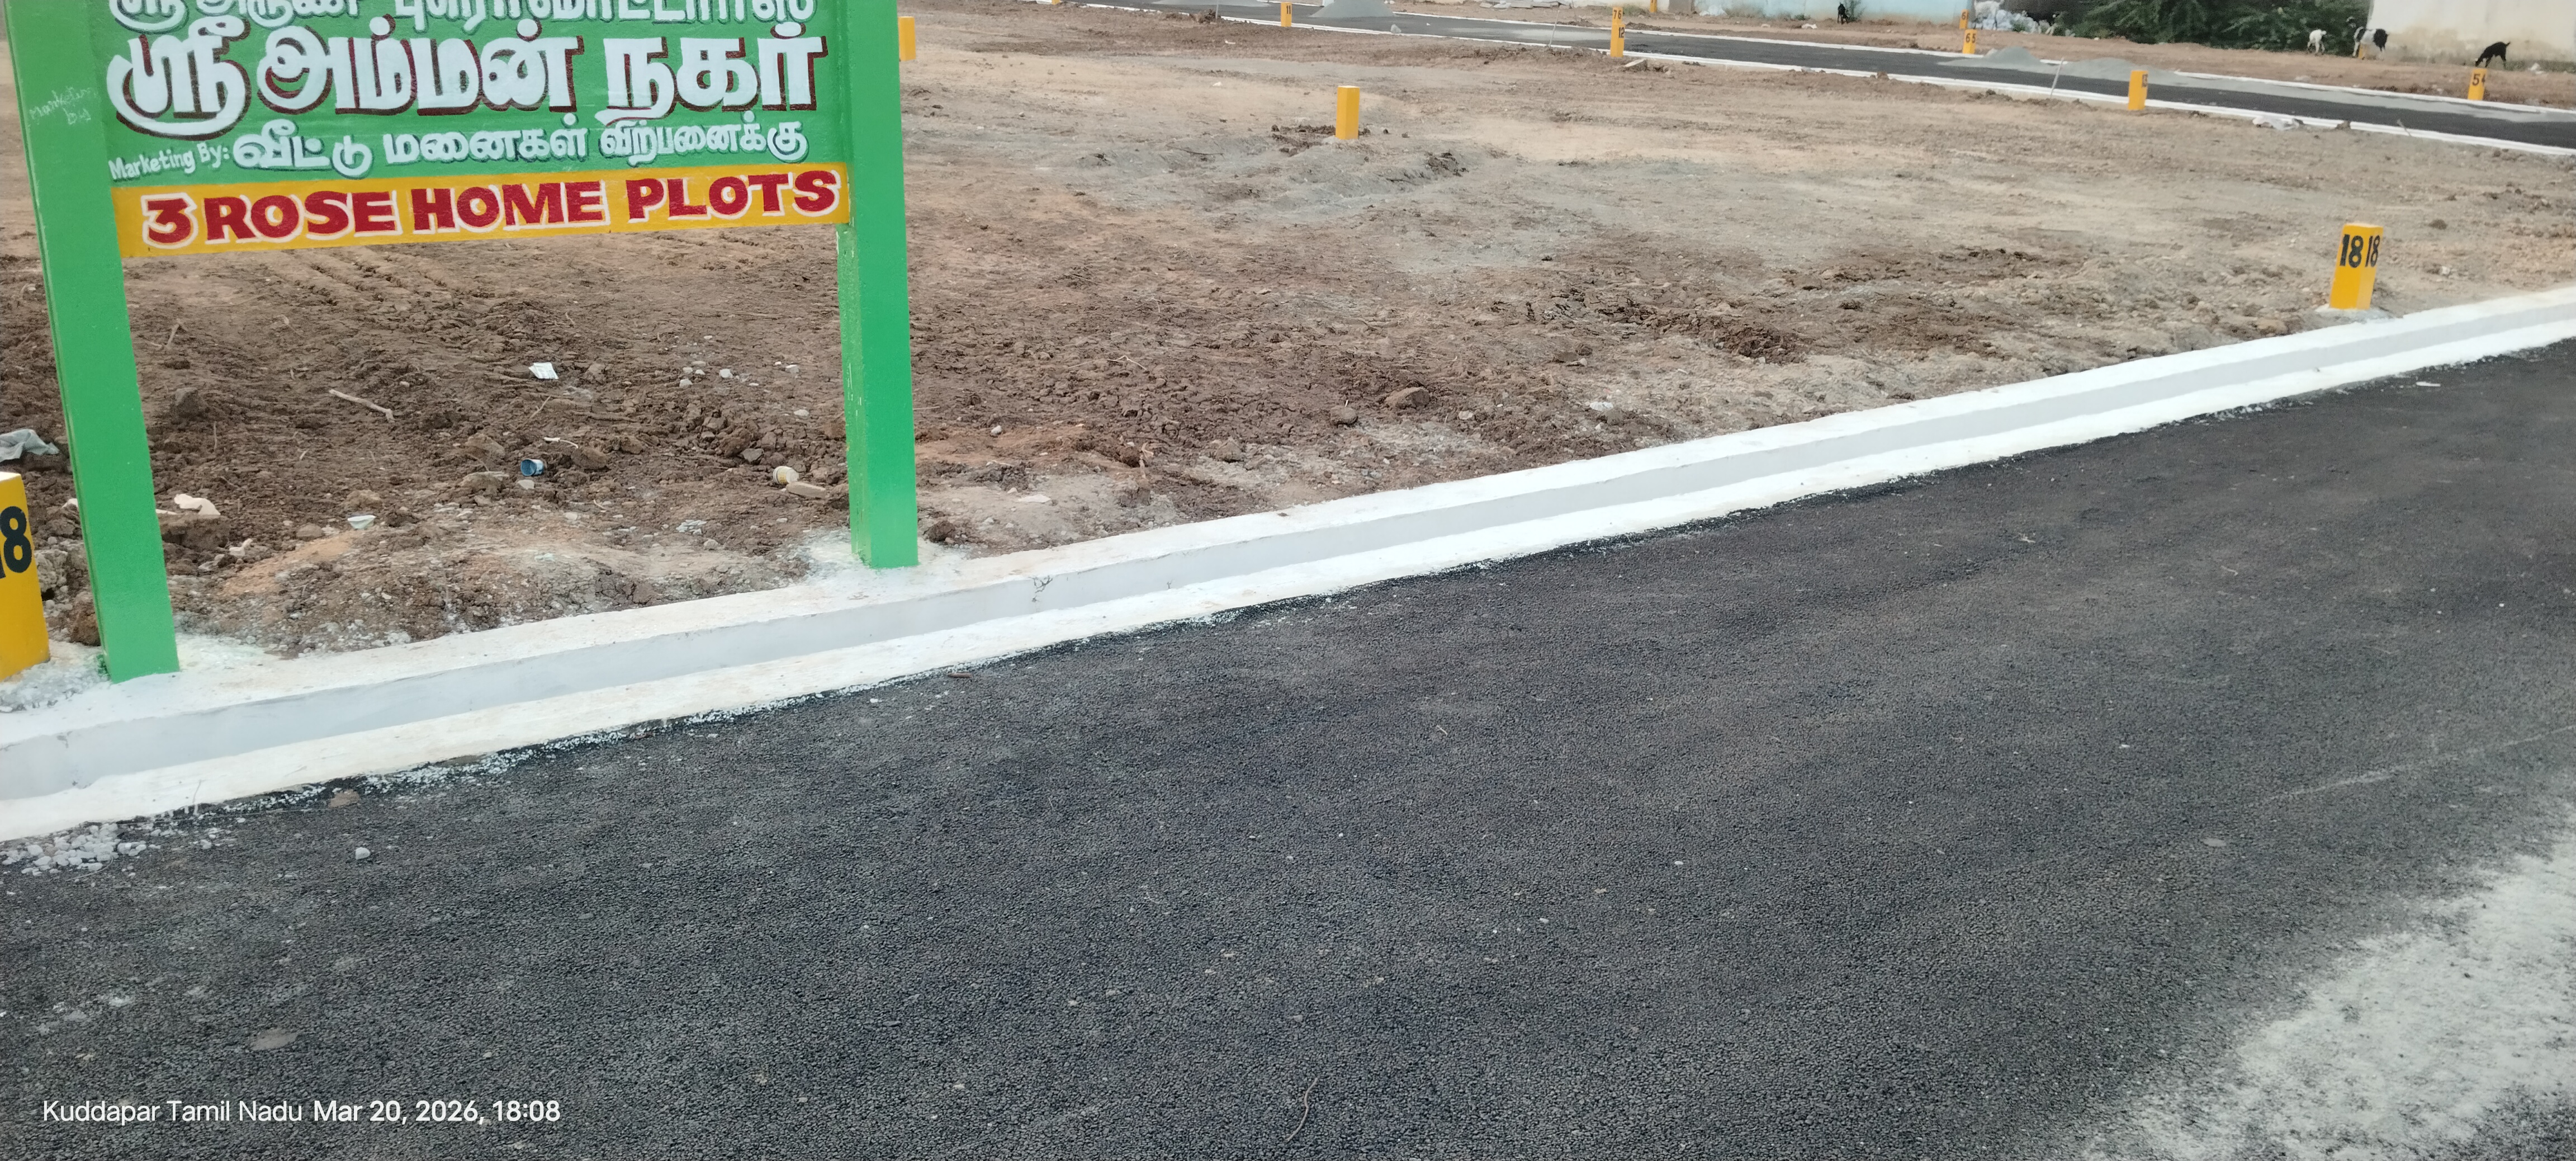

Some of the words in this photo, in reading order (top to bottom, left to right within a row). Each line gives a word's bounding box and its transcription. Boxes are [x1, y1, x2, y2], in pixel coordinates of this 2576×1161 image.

[1613, 10, 1622, 19] 76
[1618, 27, 1625, 38] 12
[1966, 33, 1976, 43] 65
[107, 16, 251, 140] ஸ்ரீ
[257, 15, 584, 115] அம்மன்
[594, 21, 828, 126] நகர்
[108, 149, 196, 180] Marketing
[197, 141, 230, 168] By:
[233, 119, 373, 178] வீட்டு
[382, 112, 589, 164] மனைகள்
[599, 110, 808, 167] விற்பனைக்கு
[141, 192, 198, 249] 3
[203, 190, 402, 244] ROSE
[410, 180, 610, 233] HOME
[624, 169, 841, 223] PLOTS
[2340, 234, 2364, 268] 18
[2365, 235, 2380, 267] 18
